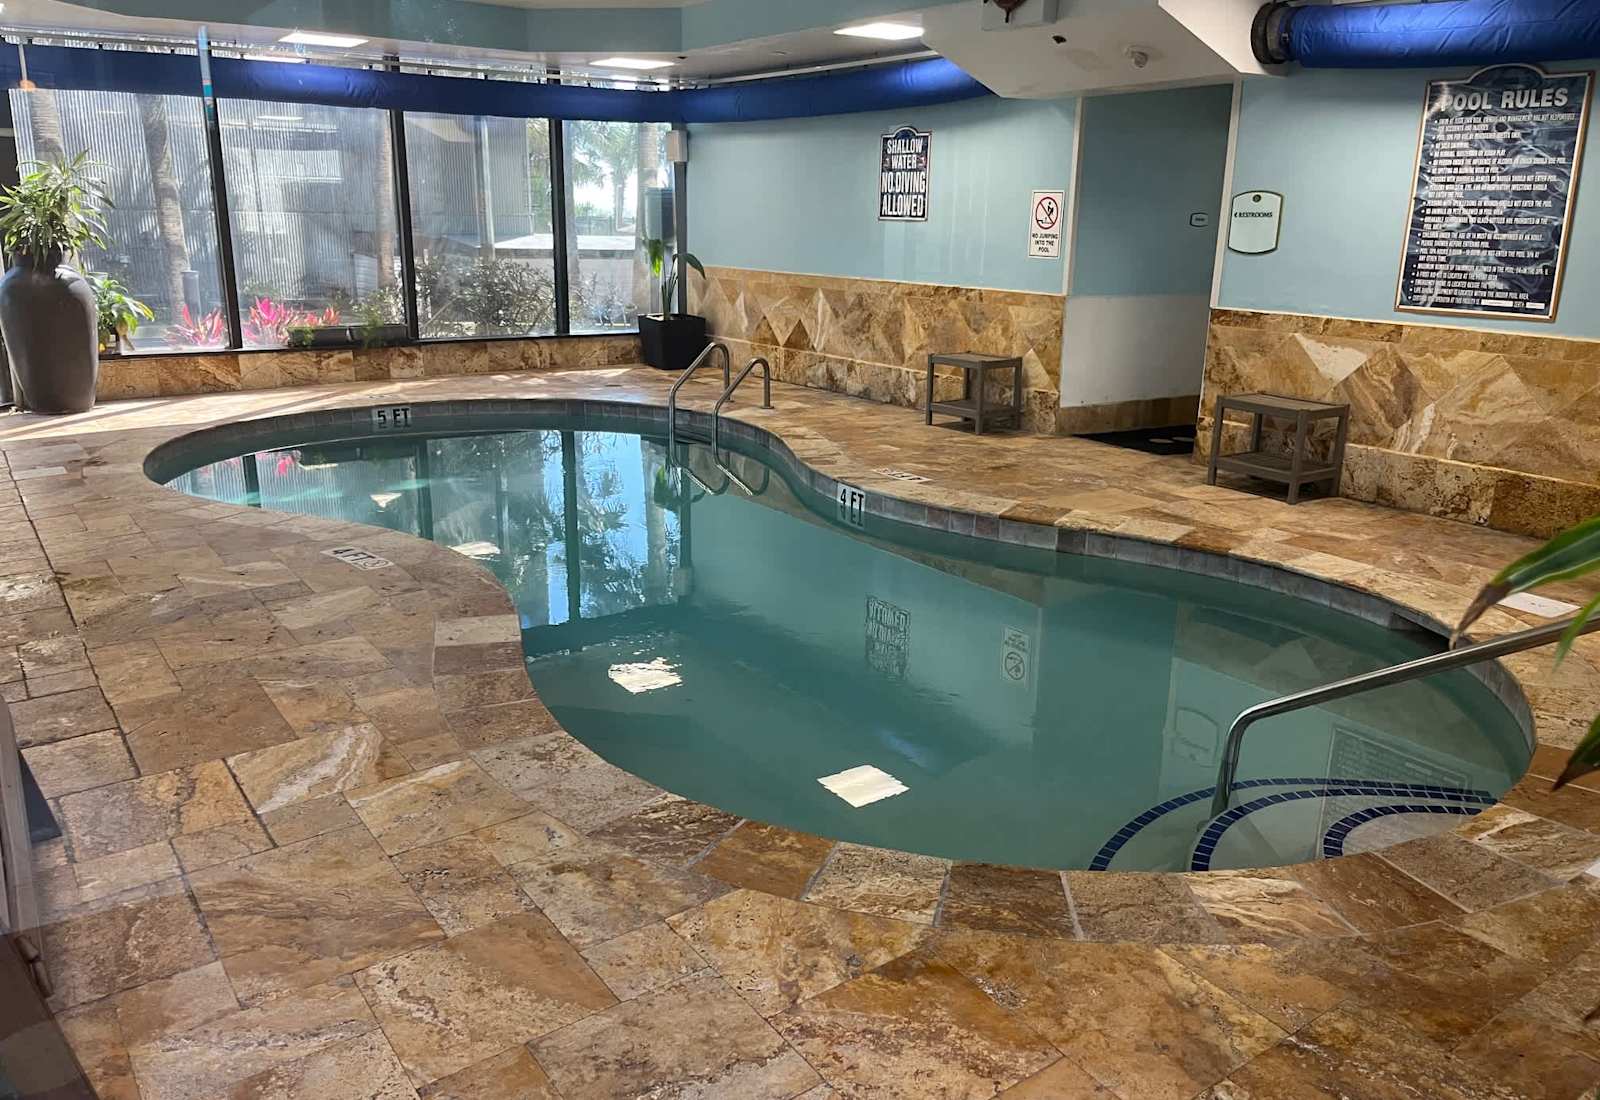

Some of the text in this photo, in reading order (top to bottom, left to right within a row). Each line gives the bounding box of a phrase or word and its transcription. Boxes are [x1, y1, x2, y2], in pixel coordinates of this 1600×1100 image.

[1440, 88, 1568, 111] POOL RULES
[887, 139, 923, 154] SHALLOW
[892, 155, 917, 169] WATER
[881, 172, 926, 193] NO DIVING
[881, 195, 924, 216] ALLOWED
[392, 407, 410, 421] FT
[840, 488, 864, 510] 4 FT
[342, 551, 377, 562] FT
